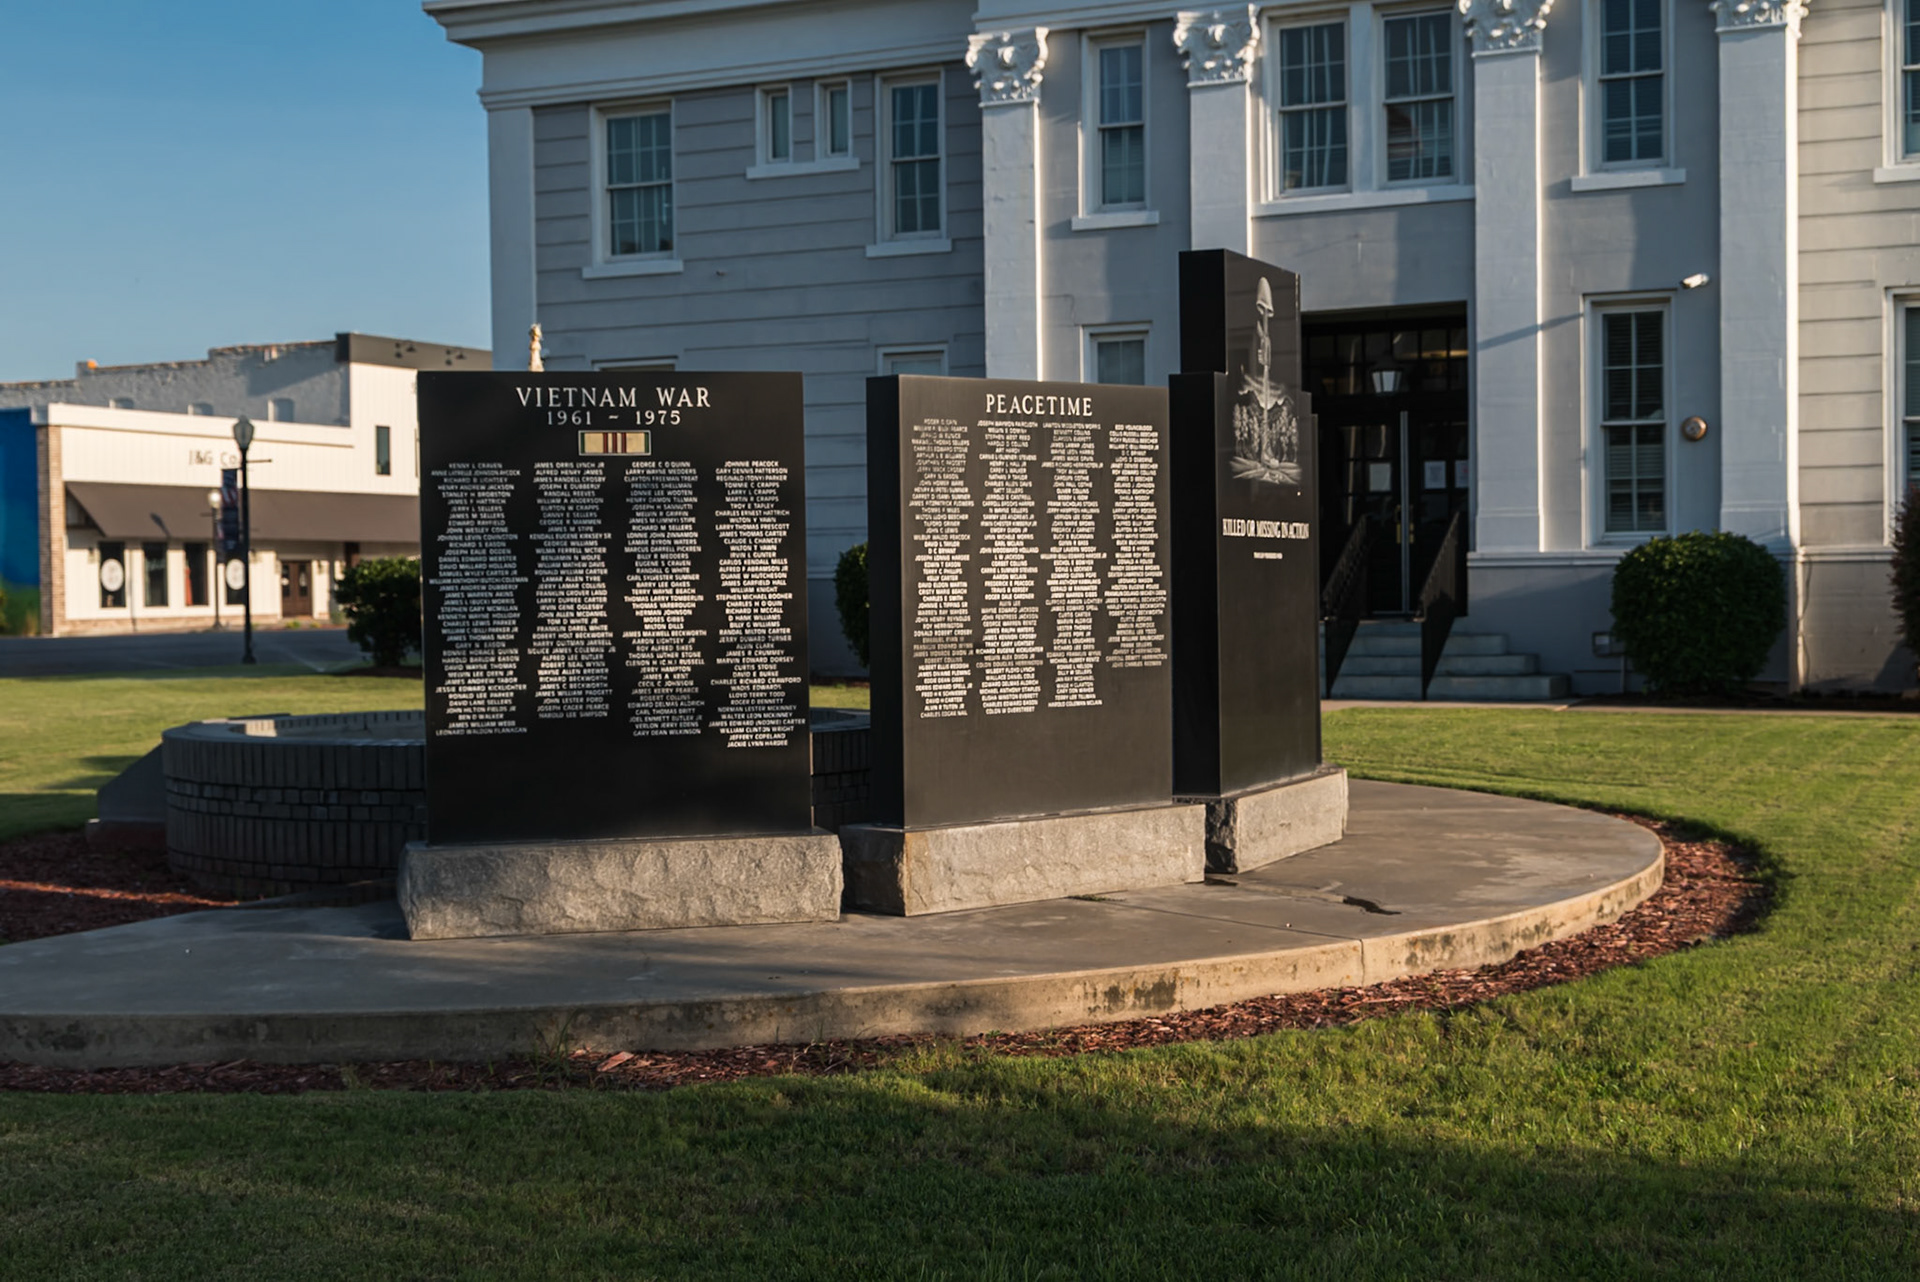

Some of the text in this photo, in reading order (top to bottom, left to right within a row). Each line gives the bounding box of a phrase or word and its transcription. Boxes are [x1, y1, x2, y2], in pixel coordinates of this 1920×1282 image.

[516, 387, 711, 407] VIETNAM WAR
[985, 393, 1093, 416] PEACETIME
[547, 411, 592, 425] 1961
[635, 410, 681, 425] 1975
[1222, 518, 1310, 539] KILLED OR MISSING IN ACTION
